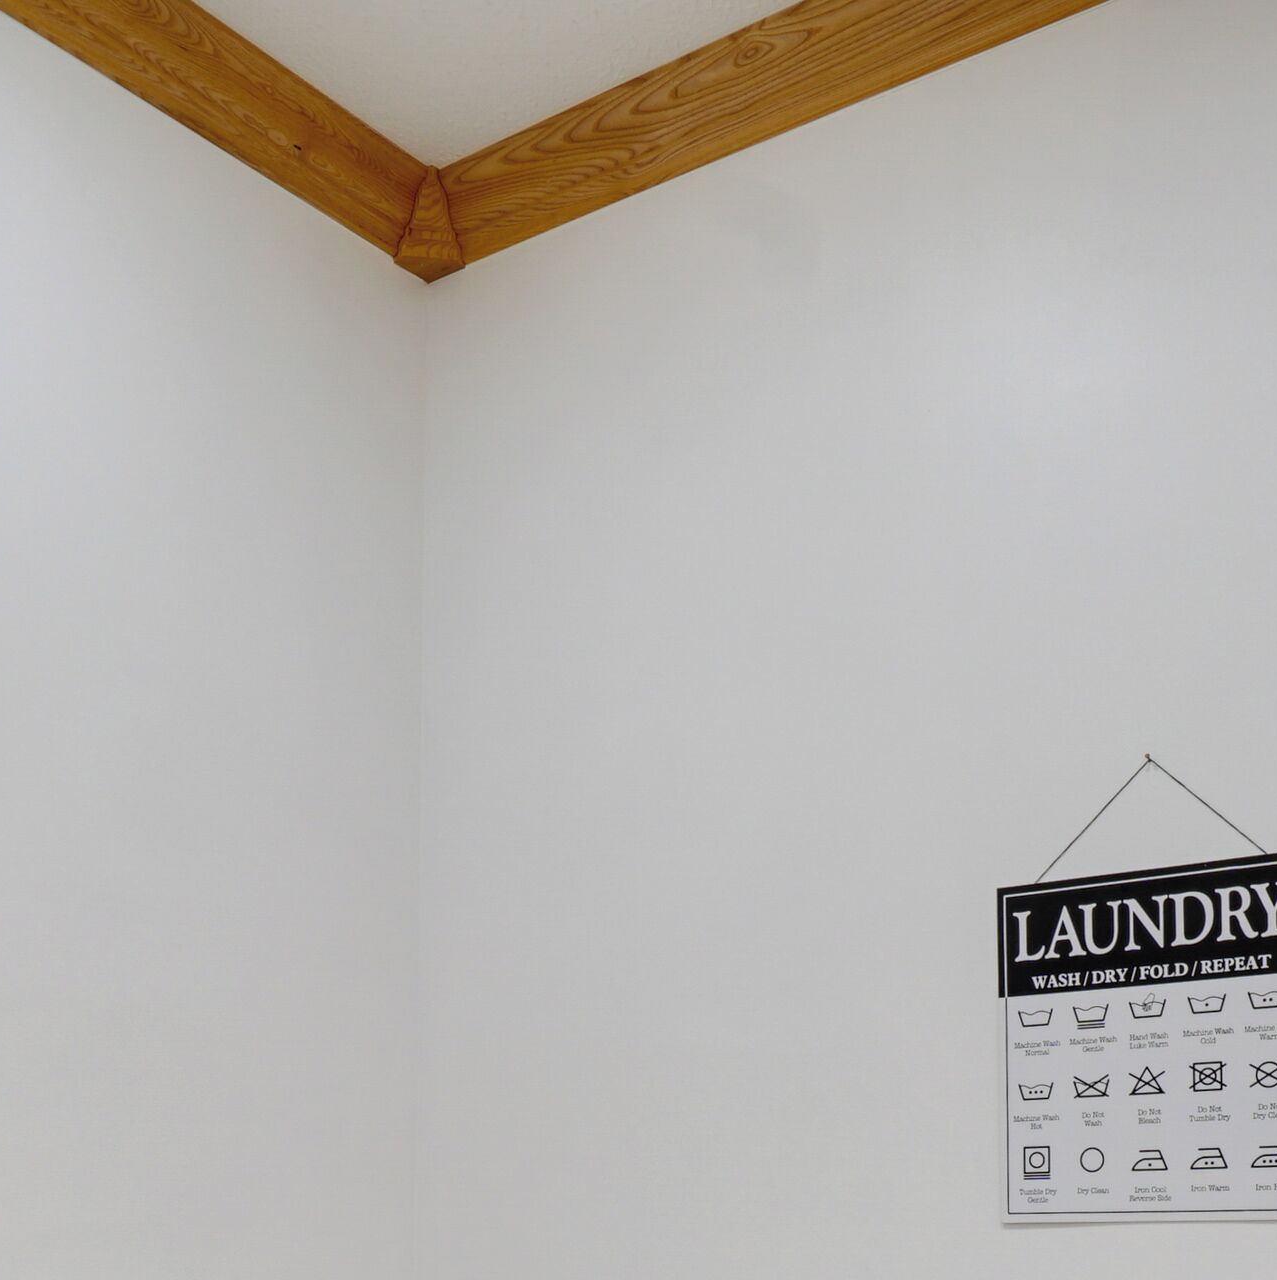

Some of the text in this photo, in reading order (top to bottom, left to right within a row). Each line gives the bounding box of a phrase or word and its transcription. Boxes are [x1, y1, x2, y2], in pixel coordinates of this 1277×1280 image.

[1032, 954, 1272, 989] WASH DRY FOLD REPEAT
[1183, 1027, 1234, 1037] Machine Wash
[1244, 1025, 1275, 1033] Machine
[1149, 1032, 1169, 1040] Wash
[1014, 1041, 1042, 1049] Machine
[1069, 1037, 1098, 1045] Machine
[1189, 1113, 1231, 1122] Tumble Dry
[1252, 1112, 1266, 1120] Dry
[1138, 1117, 1162, 1125] Bleach
[1151, 1185, 1167, 1193] Cool
[1191, 1184, 1230, 1192] Iron Warm
[1255, 1183, 1271, 1191] Iron
[1045, 1188, 1058, 1196] Dry
[1077, 1187, 1089, 1196] Dry
